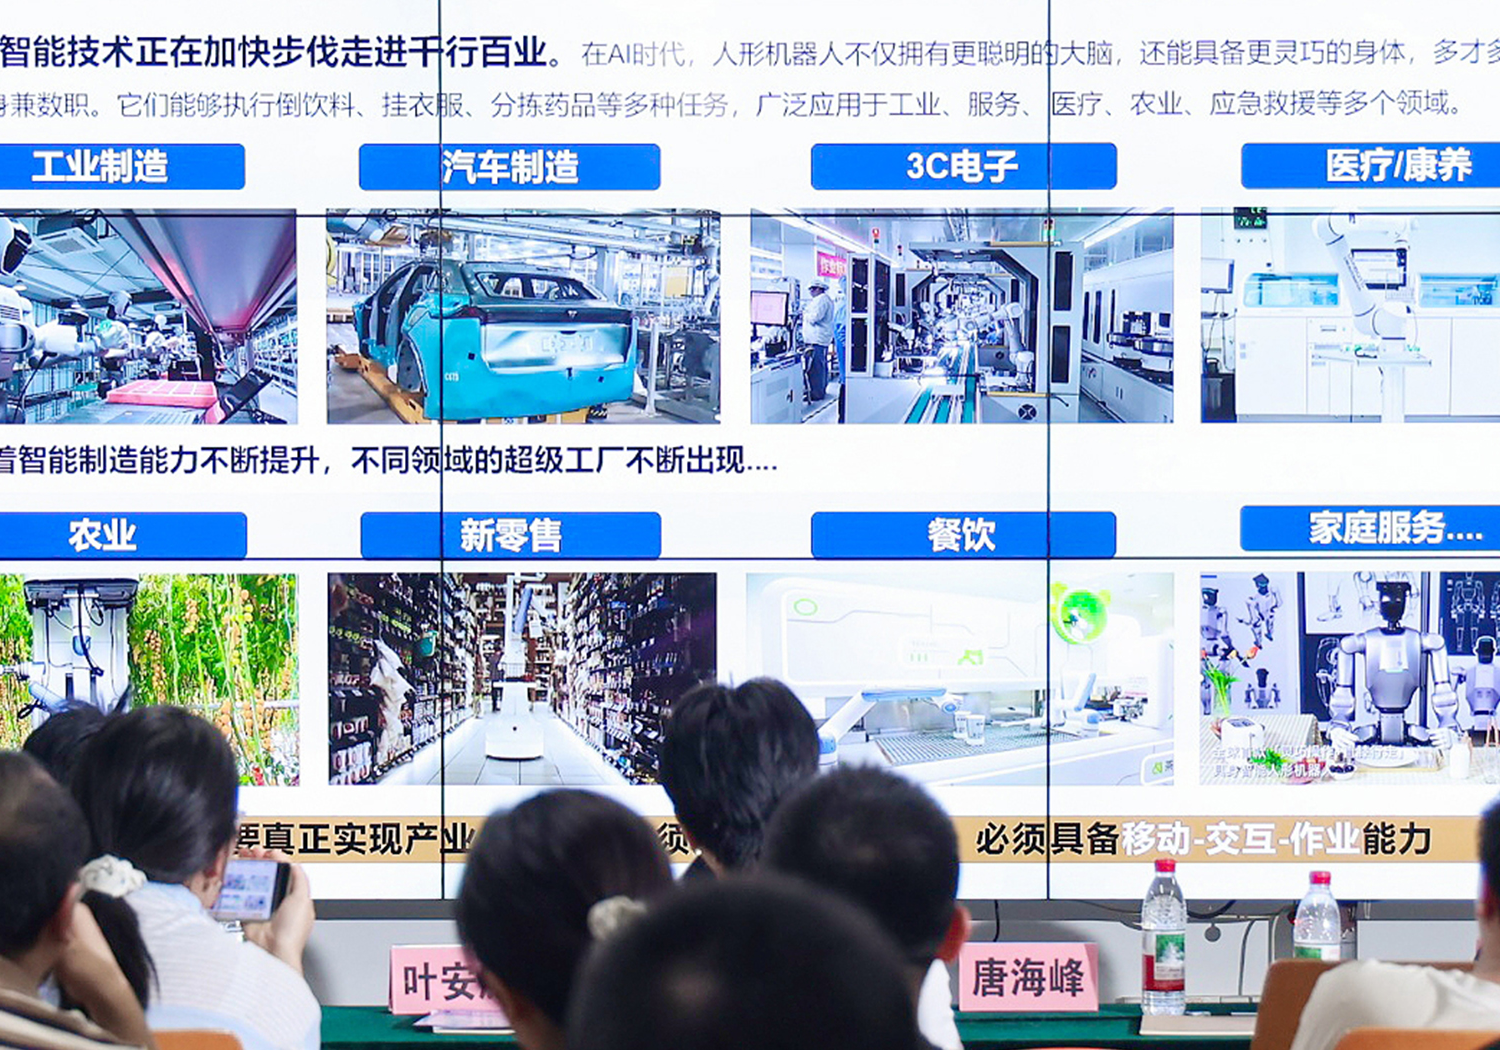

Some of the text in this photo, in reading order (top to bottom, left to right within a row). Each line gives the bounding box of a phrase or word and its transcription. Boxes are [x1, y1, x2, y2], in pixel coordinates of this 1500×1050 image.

[31, 149, 168, 184] 工业制造
[442, 149, 579, 185] 汽车制造
[906, 149, 1019, 183] 3C电子
[1326, 148, 1473, 182] 医疗/康养
[68, 517, 137, 552] 农业
[460, 517, 562, 553] 新零售
[928, 517, 996, 552] 餐饮
[976, 820, 1432, 857] 必须具备移动-交互-作业能力
[403, 961, 492, 1001] 叶安
[972, 956, 1085, 998] 唐海峰
